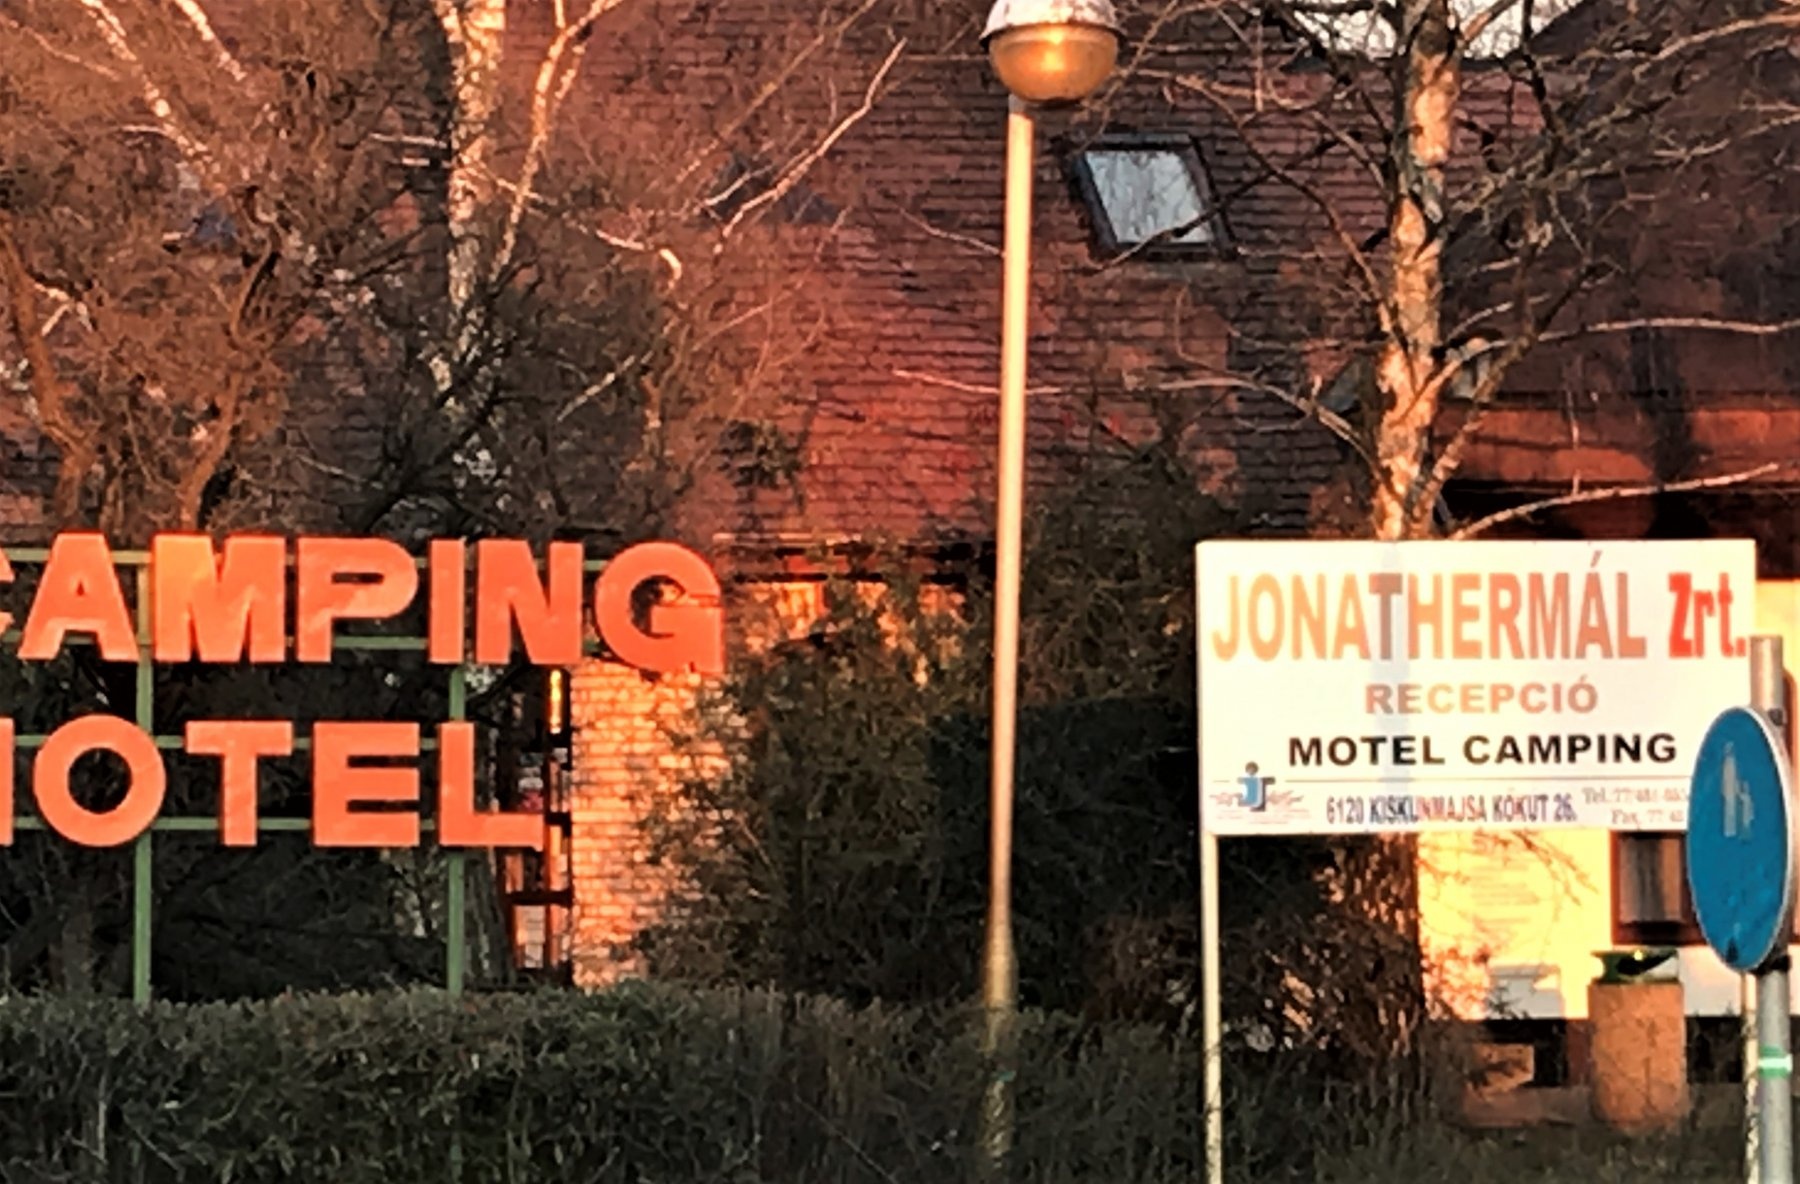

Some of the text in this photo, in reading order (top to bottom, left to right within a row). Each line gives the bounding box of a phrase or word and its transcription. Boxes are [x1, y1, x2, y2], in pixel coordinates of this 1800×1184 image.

[0, 532, 726, 675] AMPING
[1211, 551, 1747, 662] JONATHERMÁL Zrt.
[1288, 732, 1678, 767] MOTEL CAMPING
[1365, 674, 1599, 715] RECEPCIÓ
[0, 714, 546, 851] OTEL
